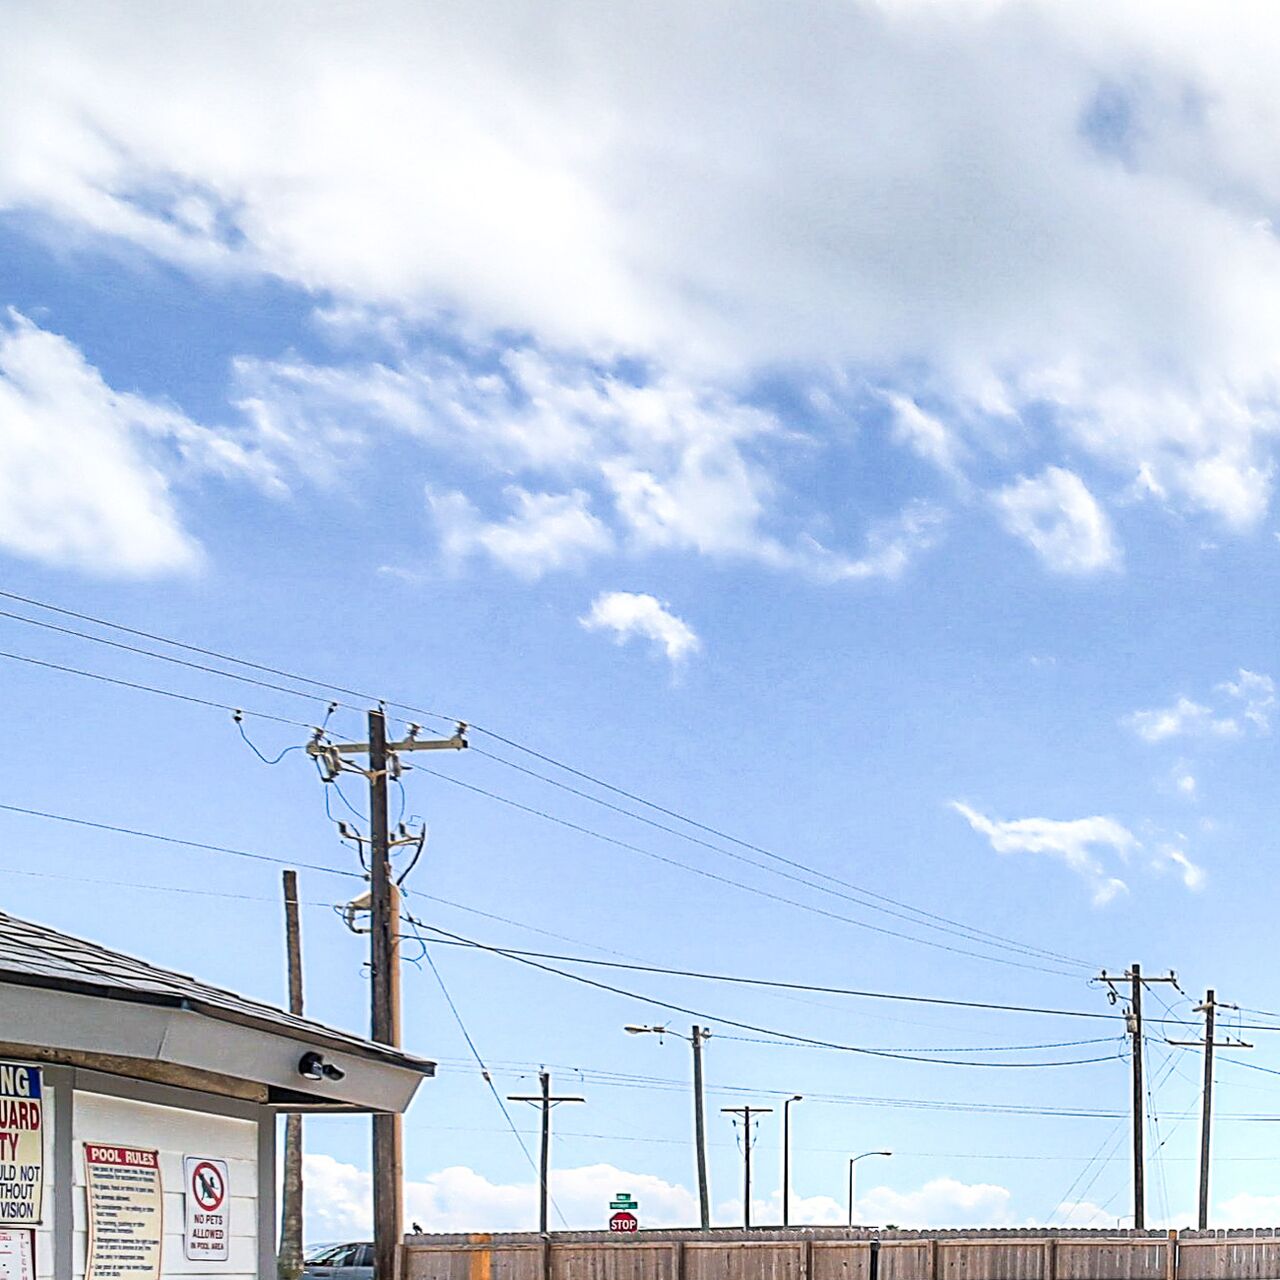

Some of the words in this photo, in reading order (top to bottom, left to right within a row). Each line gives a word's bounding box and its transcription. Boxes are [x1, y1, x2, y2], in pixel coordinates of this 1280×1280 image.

[91, 1148, 122, 1162] POOL
[125, 1151, 155, 1166] RULES
[20, 1165, 40, 1182] NOT
[194, 1214, 204, 1224] NO
[206, 1215, 223, 1225] PETS
[611, 1220, 636, 1230] STOP
[193, 1229, 224, 1239] ALLOWED
